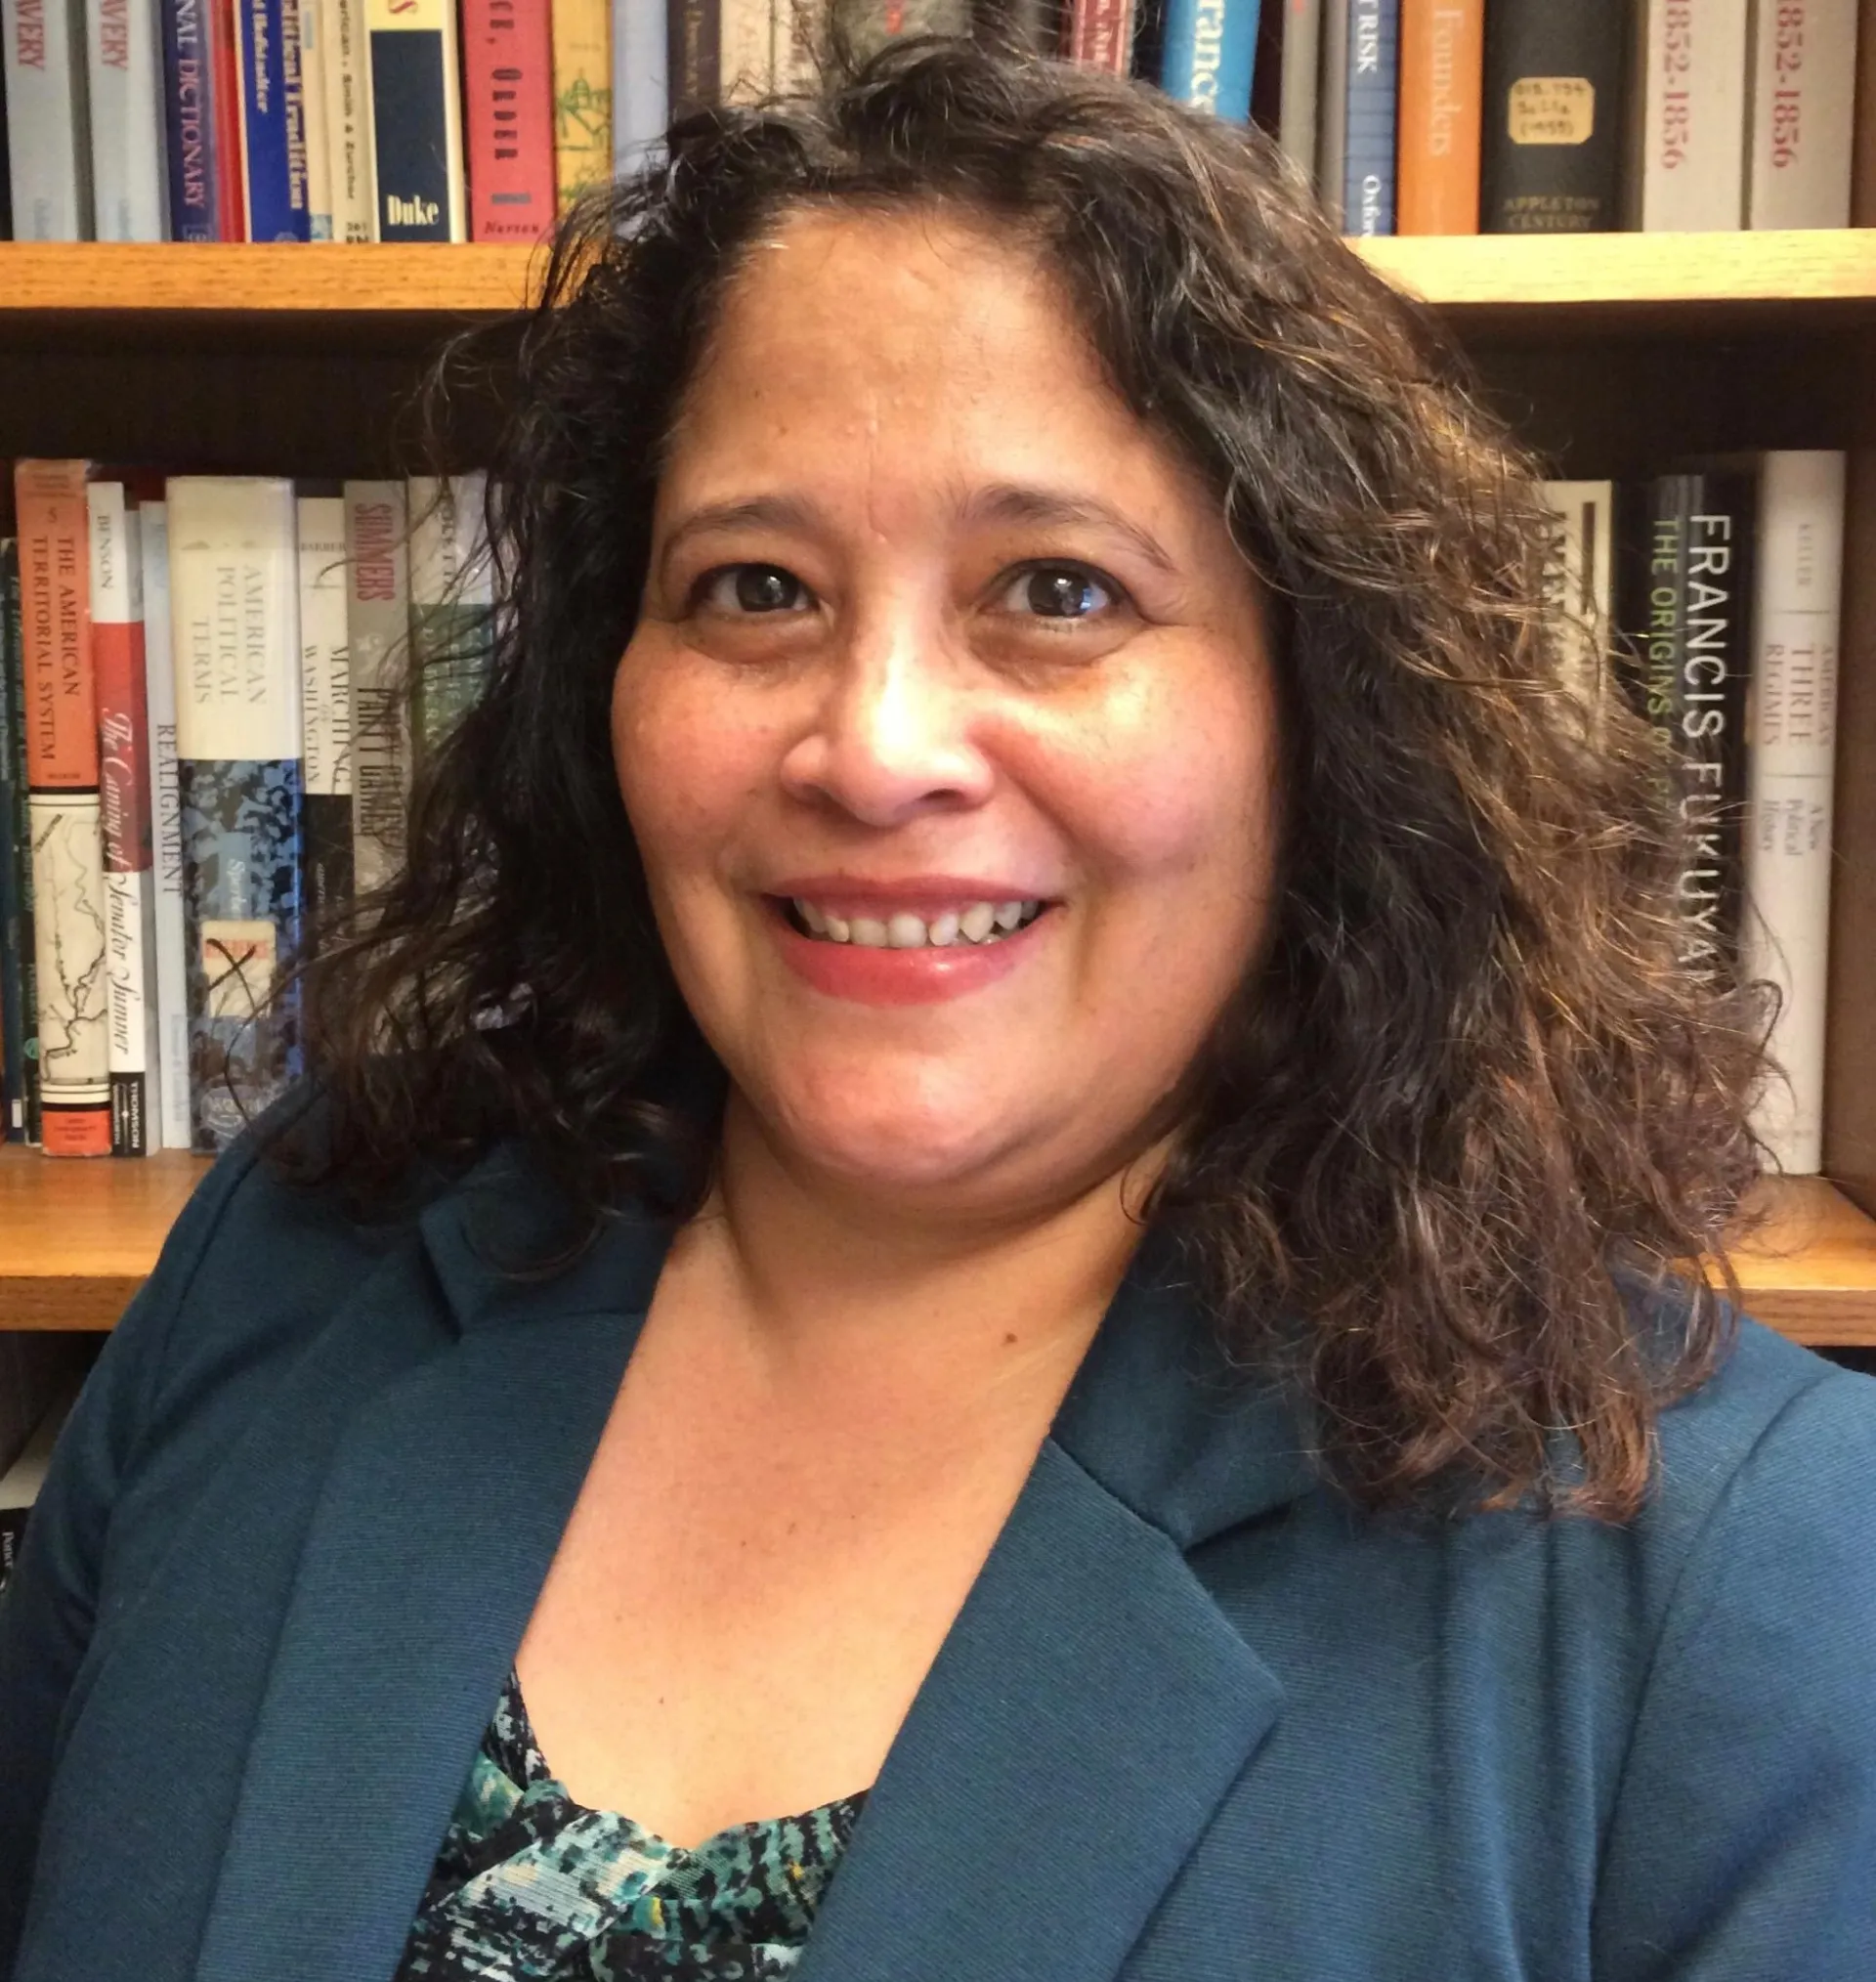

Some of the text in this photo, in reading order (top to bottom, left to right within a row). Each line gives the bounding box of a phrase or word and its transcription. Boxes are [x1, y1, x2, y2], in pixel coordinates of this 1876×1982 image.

[1357, 15, 1380, 74] RISK
[1428, 11, 1465, 156] Founders
[1662, 0, 1691, 169] 852-1856
[1773, 0, 1806, 168] 852-1856
[178, 59, 205, 207] DICTIONARY
[285, 89, 309, 209] Tradition
[387, 194, 440, 226] Duke
[1504, 196, 1599, 212] APPLETON
[1508, 214, 1593, 230] CENTURY
[97, 514, 114, 589] BENSON
[355, 503, 396, 601] SUMMERS
[1649, 516, 1681, 576] THE
[1797, 522, 1814, 587] KELLER
[31, 536, 57, 760] TERRITORIAL SYSTEM
[58, 536, 81, 697] THE AMERICAN
[191, 616, 213, 705] TERMS
[215, 566, 238, 704] POLITICAL
[243, 563, 268, 706] AMERICAN
[1645, 586, 1679, 716] ORIGINS
[1682, 514, 1731, 740] FRANCIS
[305, 644, 320, 781] WASHINGTON
[330, 644, 351, 781] MARCHING
[357, 686, 403, 754] PARTY
[1762, 643, 1786, 747] REGIMES
[1789, 643, 1815, 745] THREE
[156, 723, 183, 896] REALIGNMENT
[1759, 799, 1780, 851] History
[1783, 799, 1805, 855] Political
[101, 708, 142, 1055] The Caning of Senator Sumner
[129, 1081, 140, 1148] THOMSON
